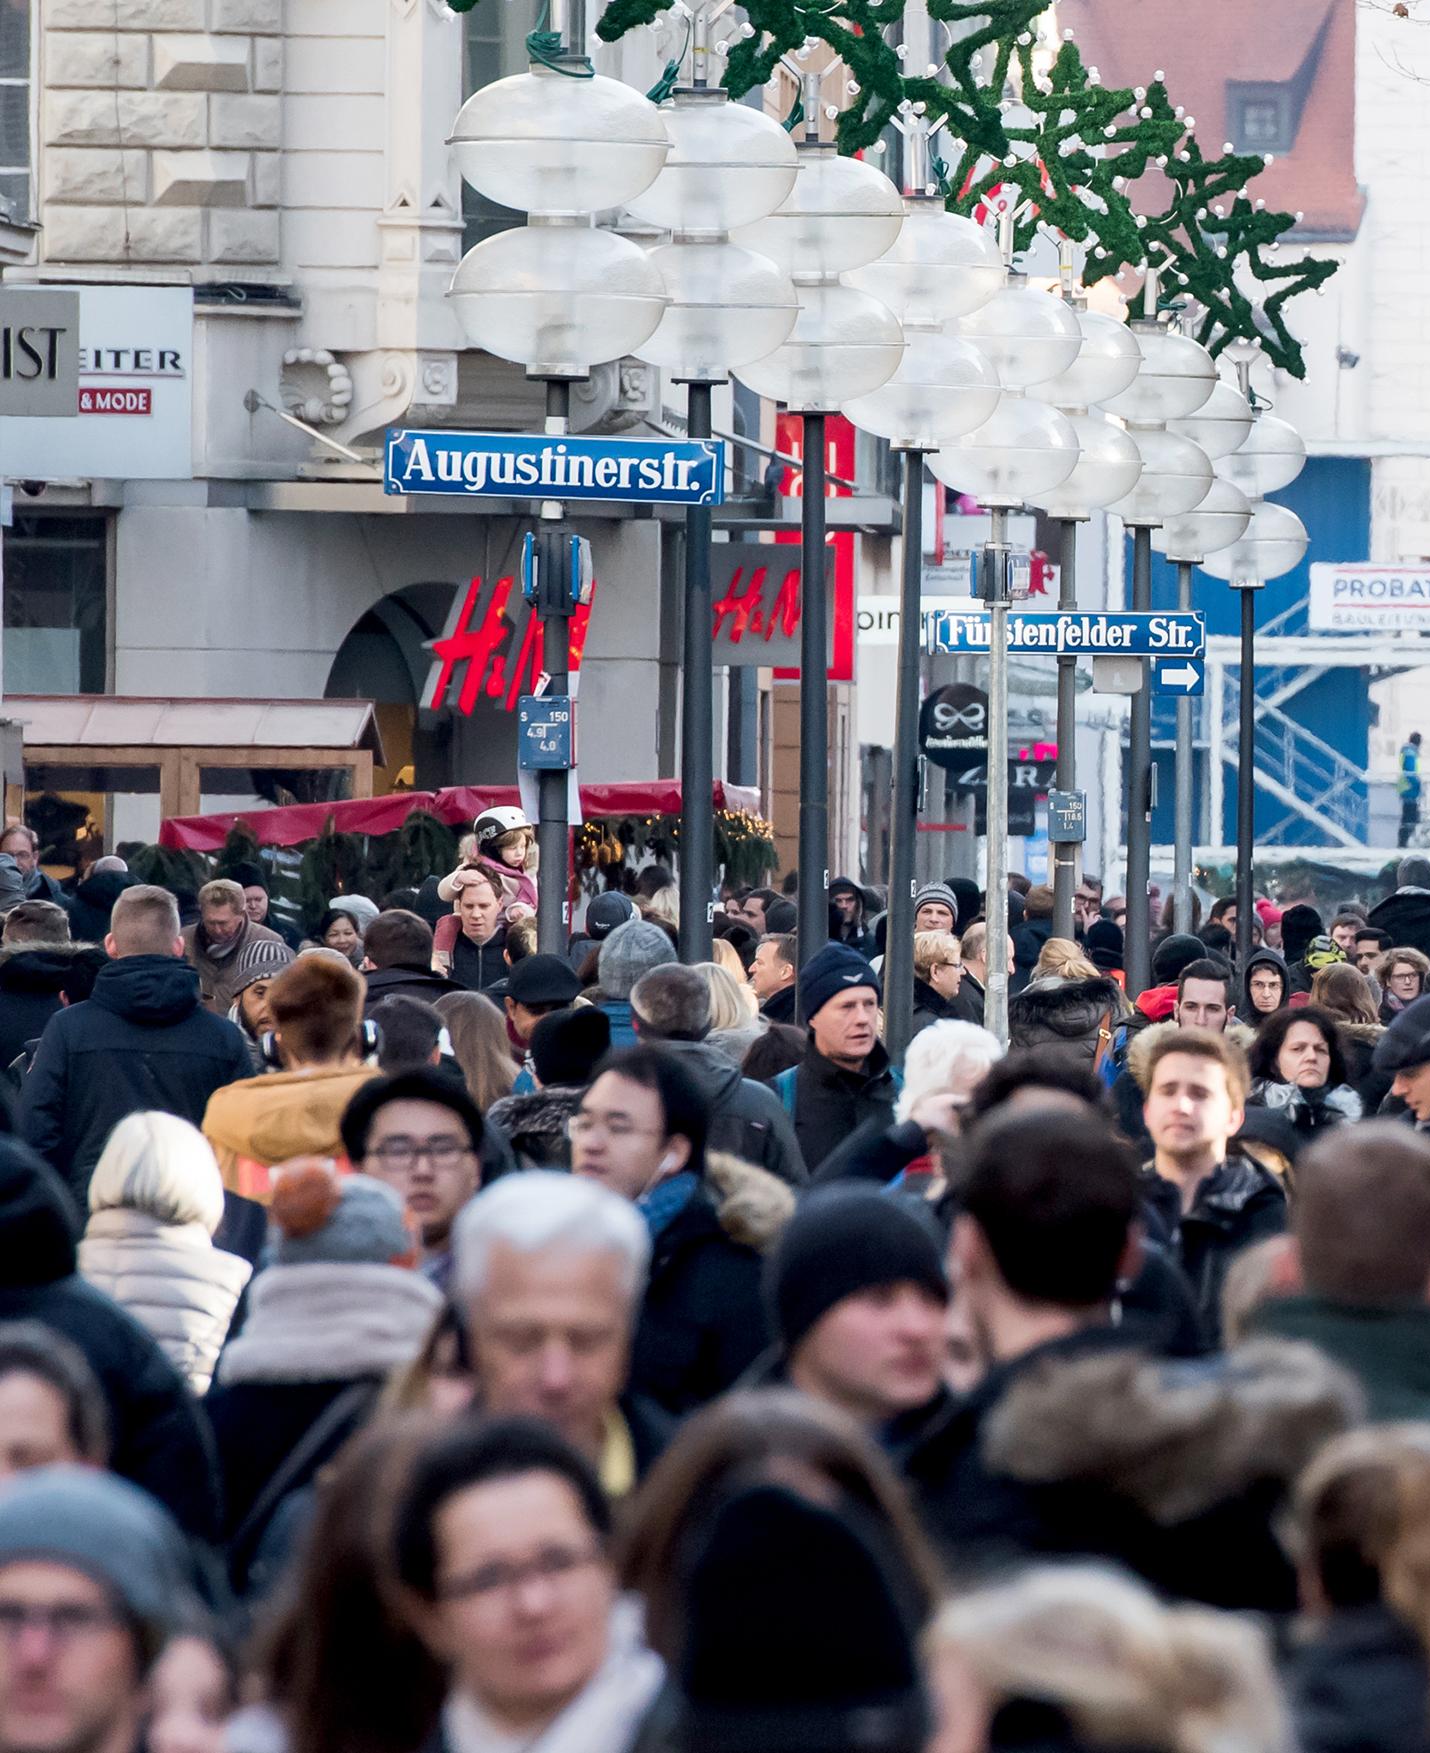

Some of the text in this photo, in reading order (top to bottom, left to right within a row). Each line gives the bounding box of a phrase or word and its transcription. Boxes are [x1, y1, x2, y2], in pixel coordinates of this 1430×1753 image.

[3, 326, 67, 380] IST
[80, 392, 147, 411] & MODE
[402, 438, 701, 492] Augustinerstr.
[1148, 617, 1194, 648] Str.
[520, 711, 569, 722] S 150
